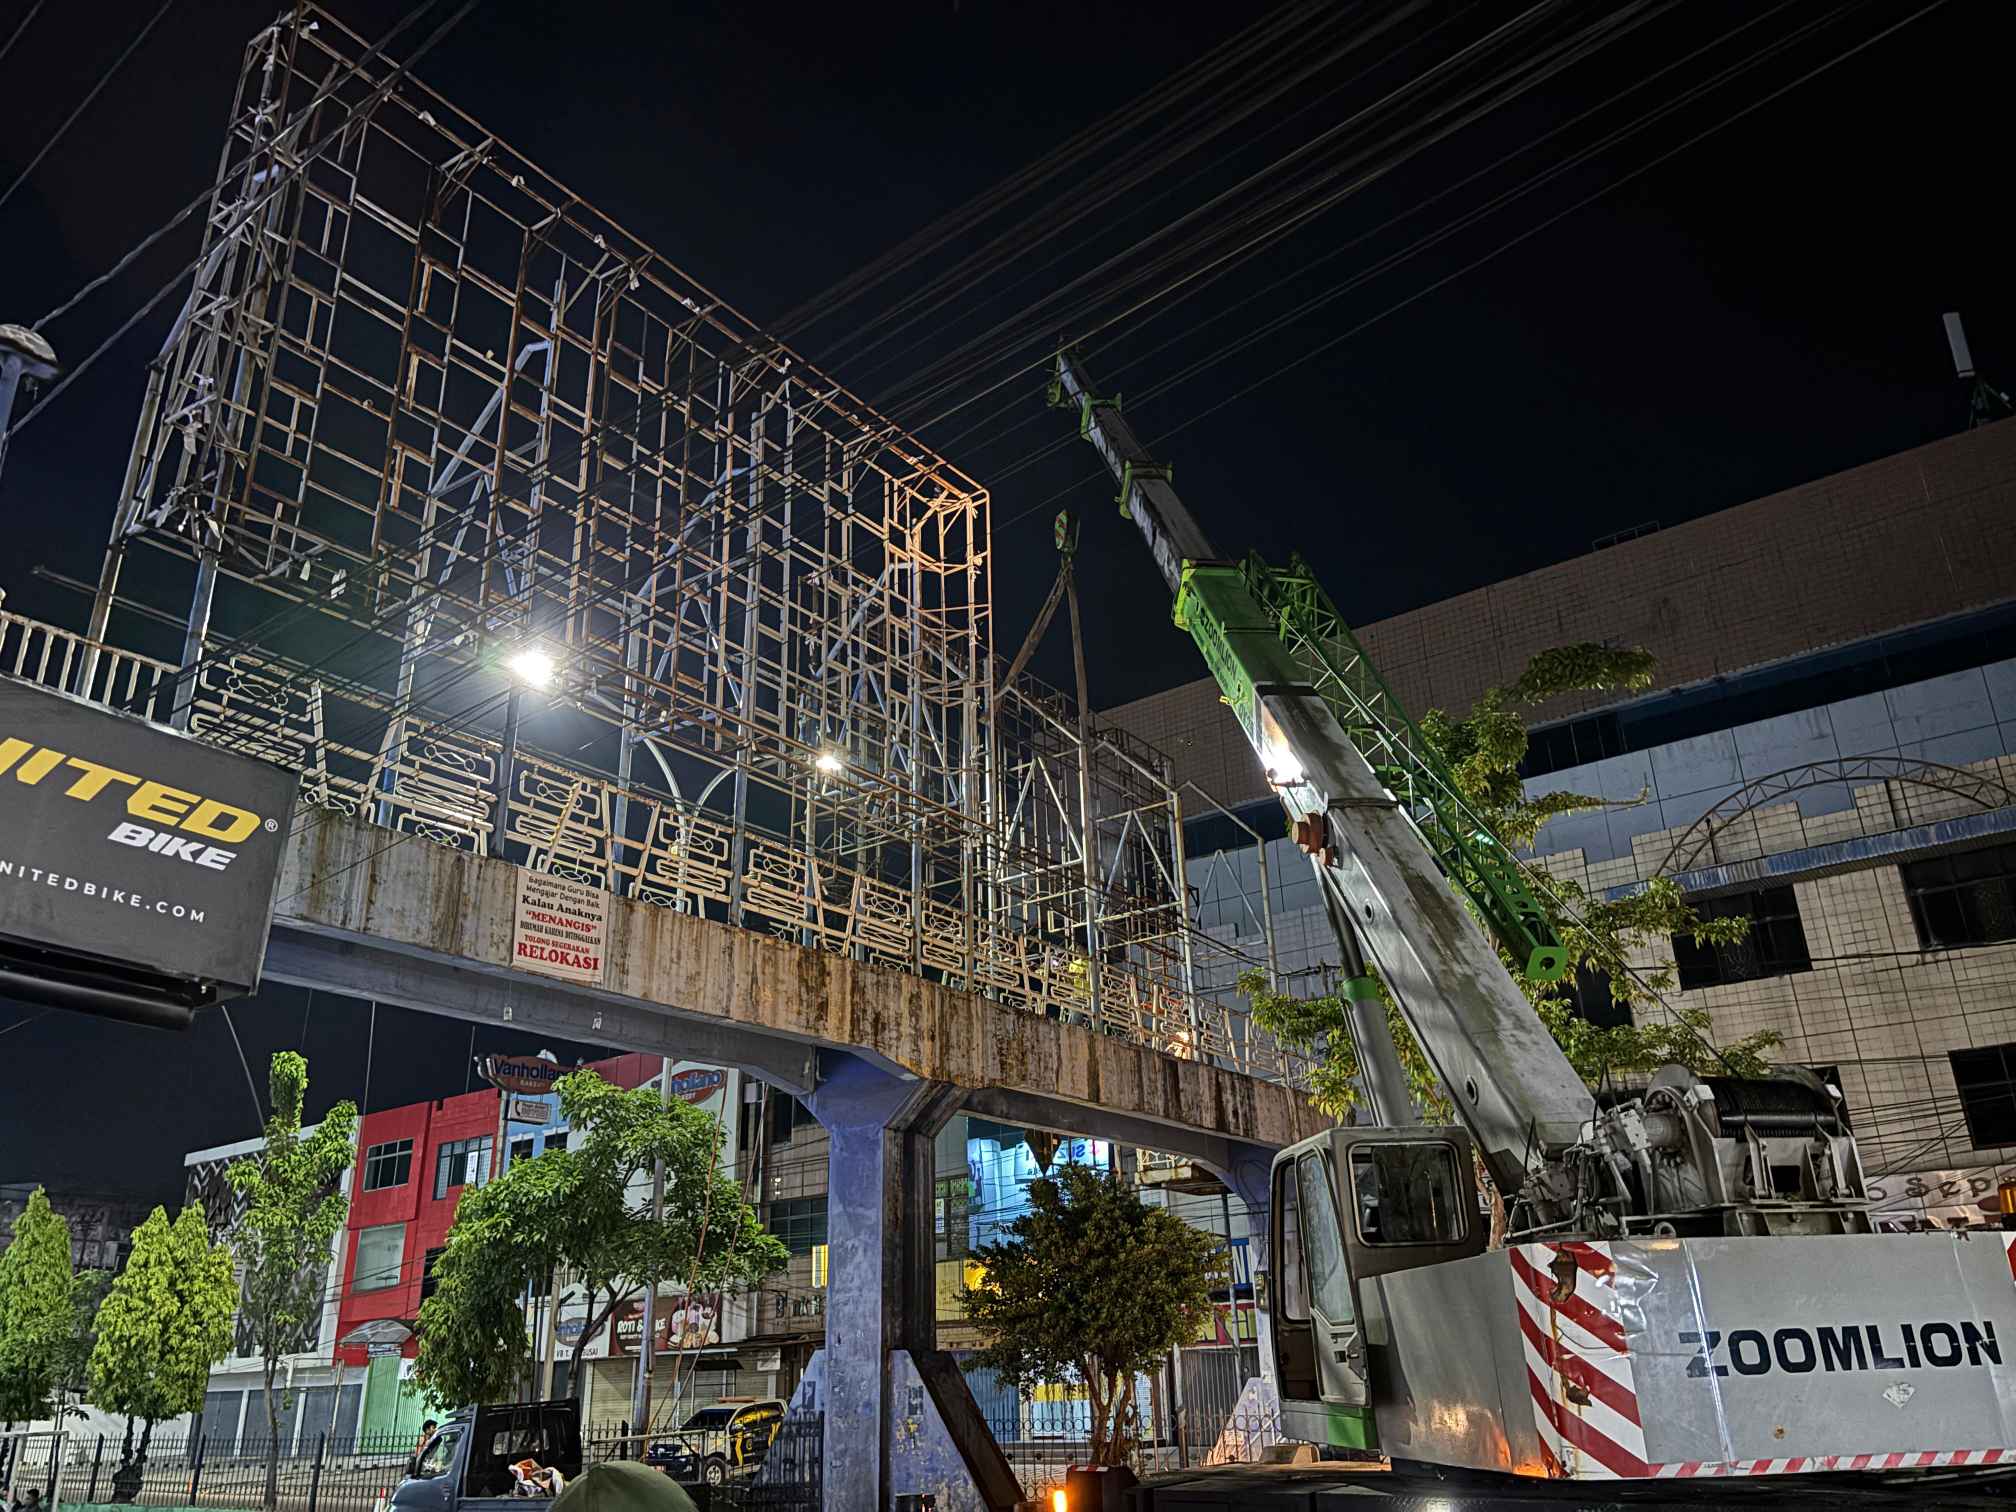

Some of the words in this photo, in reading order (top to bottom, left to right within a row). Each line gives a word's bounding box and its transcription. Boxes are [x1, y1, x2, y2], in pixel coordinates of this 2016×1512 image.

[107, 821, 237, 871] BIKE
[526, 884, 558, 899] Mengajar
[559, 893, 585, 906] Dengan
[586, 898, 600, 908] Baik
[528, 875, 566, 892] Bagaimana
[567, 885, 585, 896] Guru
[585, 889, 599, 900] Bisa
[521, 894, 554, 910] Kalau
[556, 903, 602, 922] Anaknya
[517, 942, 599, 970] RELOKASI
[524, 934, 550, 946] TOLONG
[551, 940, 590, 954] SEGERAKAN
[617, 1320, 636, 1334] ROTI
[1678, 1321, 2002, 1378] ZOOMLION
